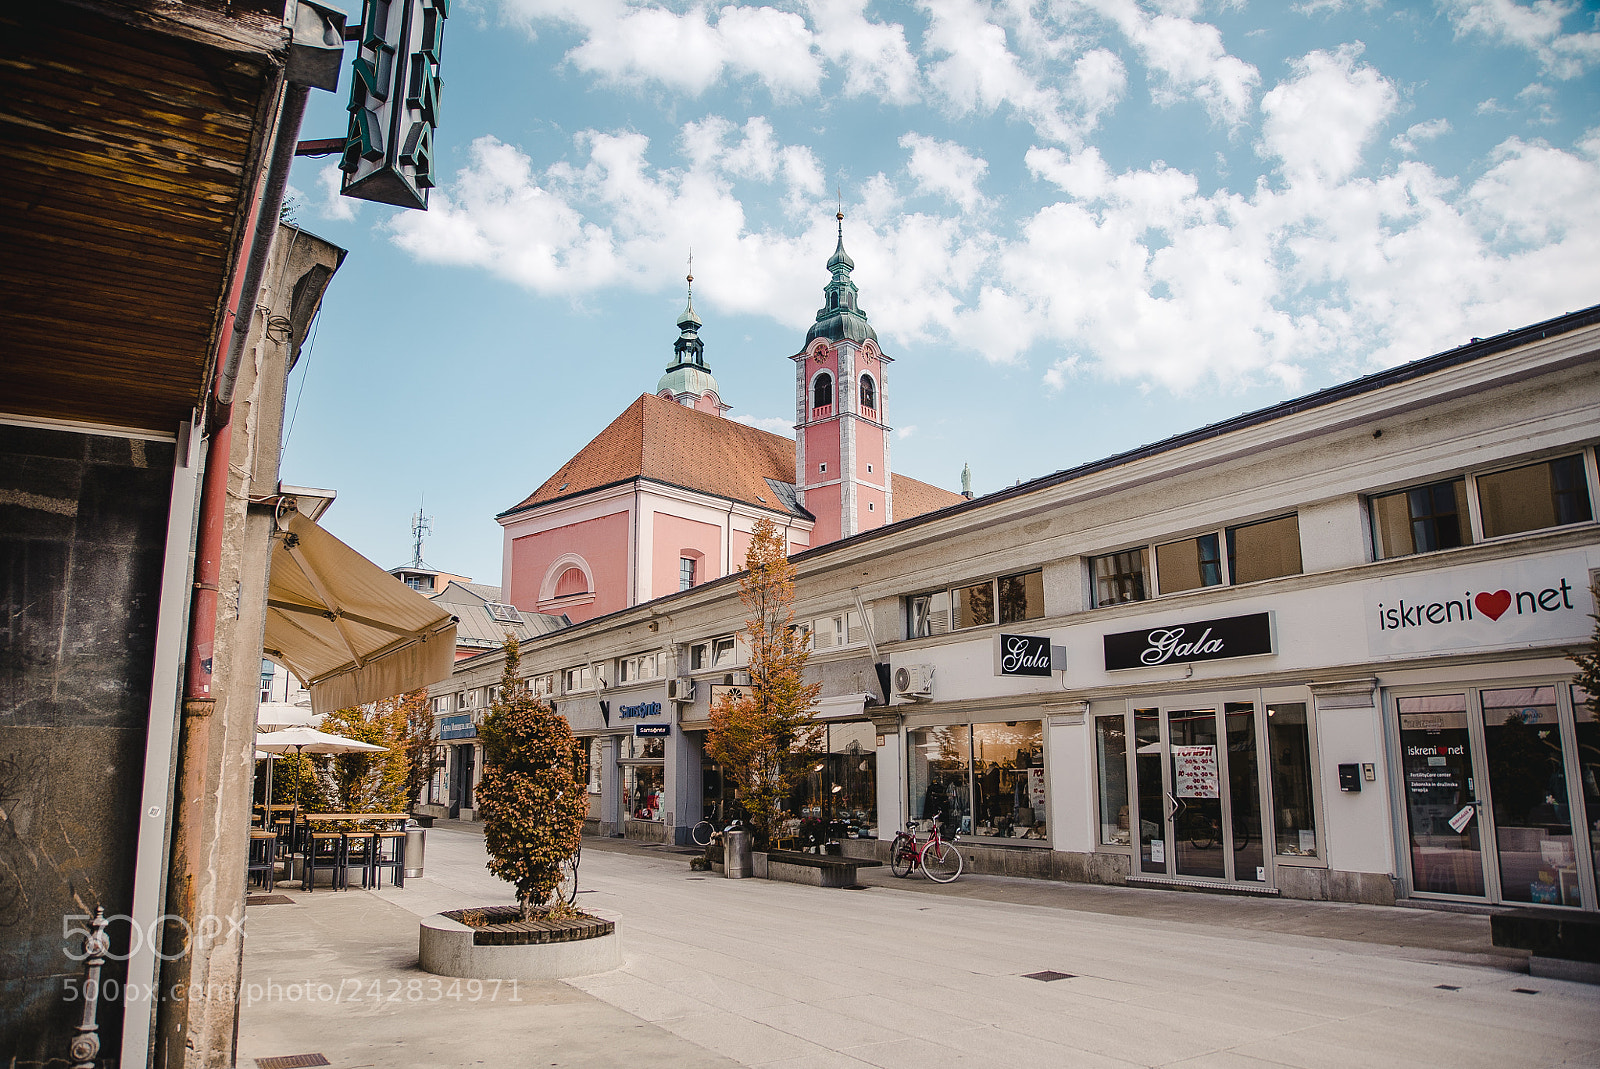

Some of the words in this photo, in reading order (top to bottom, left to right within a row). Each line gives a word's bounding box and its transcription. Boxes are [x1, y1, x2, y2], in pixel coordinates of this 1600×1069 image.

[1378, 590, 1473, 631] iskreni
[1515, 577, 1574, 615] net
[1003, 637, 1050, 672] Gala
[1140, 627, 1225, 665] Gala
[618, 701, 661, 719] Samsonite
[1407, 744, 1437, 756] iskreni
[1447, 744, 1465, 755] net
